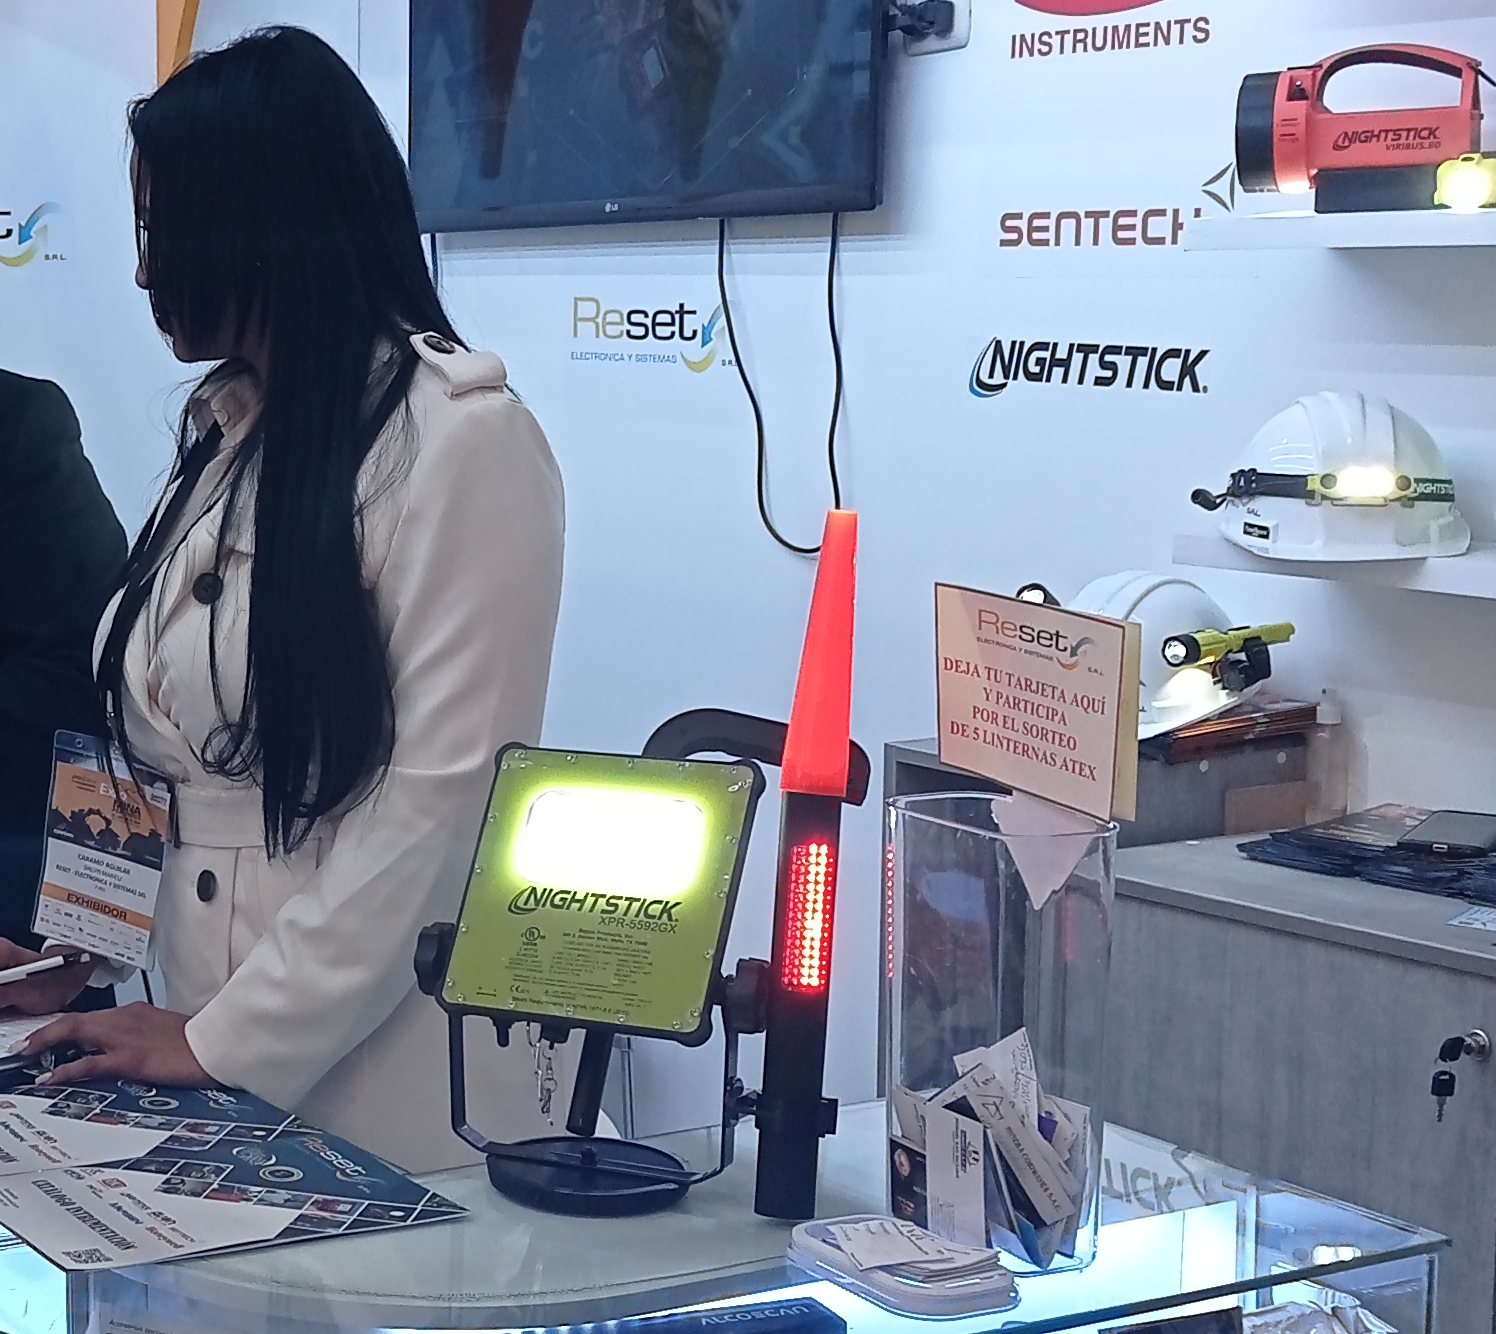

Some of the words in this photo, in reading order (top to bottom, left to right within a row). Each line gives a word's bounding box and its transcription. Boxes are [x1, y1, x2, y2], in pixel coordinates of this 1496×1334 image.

[1010, 16, 1211, 59] INSTRUMENTS
[1341, 126, 1441, 145] NIGHTSTICK
[572, 296, 698, 341] Reset
[571, 351, 625, 362] ELECTRONICA
[982, 337, 1211, 394] NIGHTSTICK
[978, 608, 1068, 653] Reset
[942, 656, 981, 679] DEJA
[984, 665, 1003, 684] TU
[1005, 671, 1067, 705] TARJETA
[1070, 692, 1107, 716] AQUÍ
[983, 686, 993, 703] Y
[995, 690, 1068, 727] PARTICIPA
[972, 705, 999, 728] POR
[1002, 714, 1020, 733] EL
[1022, 720, 1077, 752] SORTEO
[950, 720, 970, 740] DE
[972, 726, 980, 741] 5
[982, 728, 1058, 768] LINTERNAS
[1059, 756, 1097, 782] ATEX
[66, 892, 128, 922] EXHIBIDOR
[519, 886, 682, 923] NIGHTSTICK
[598, 915, 678, 934] XPR-5592GX
[303, 1135, 367, 1176] Reset
[699, 1305, 810, 1327] ALCOSCAN
